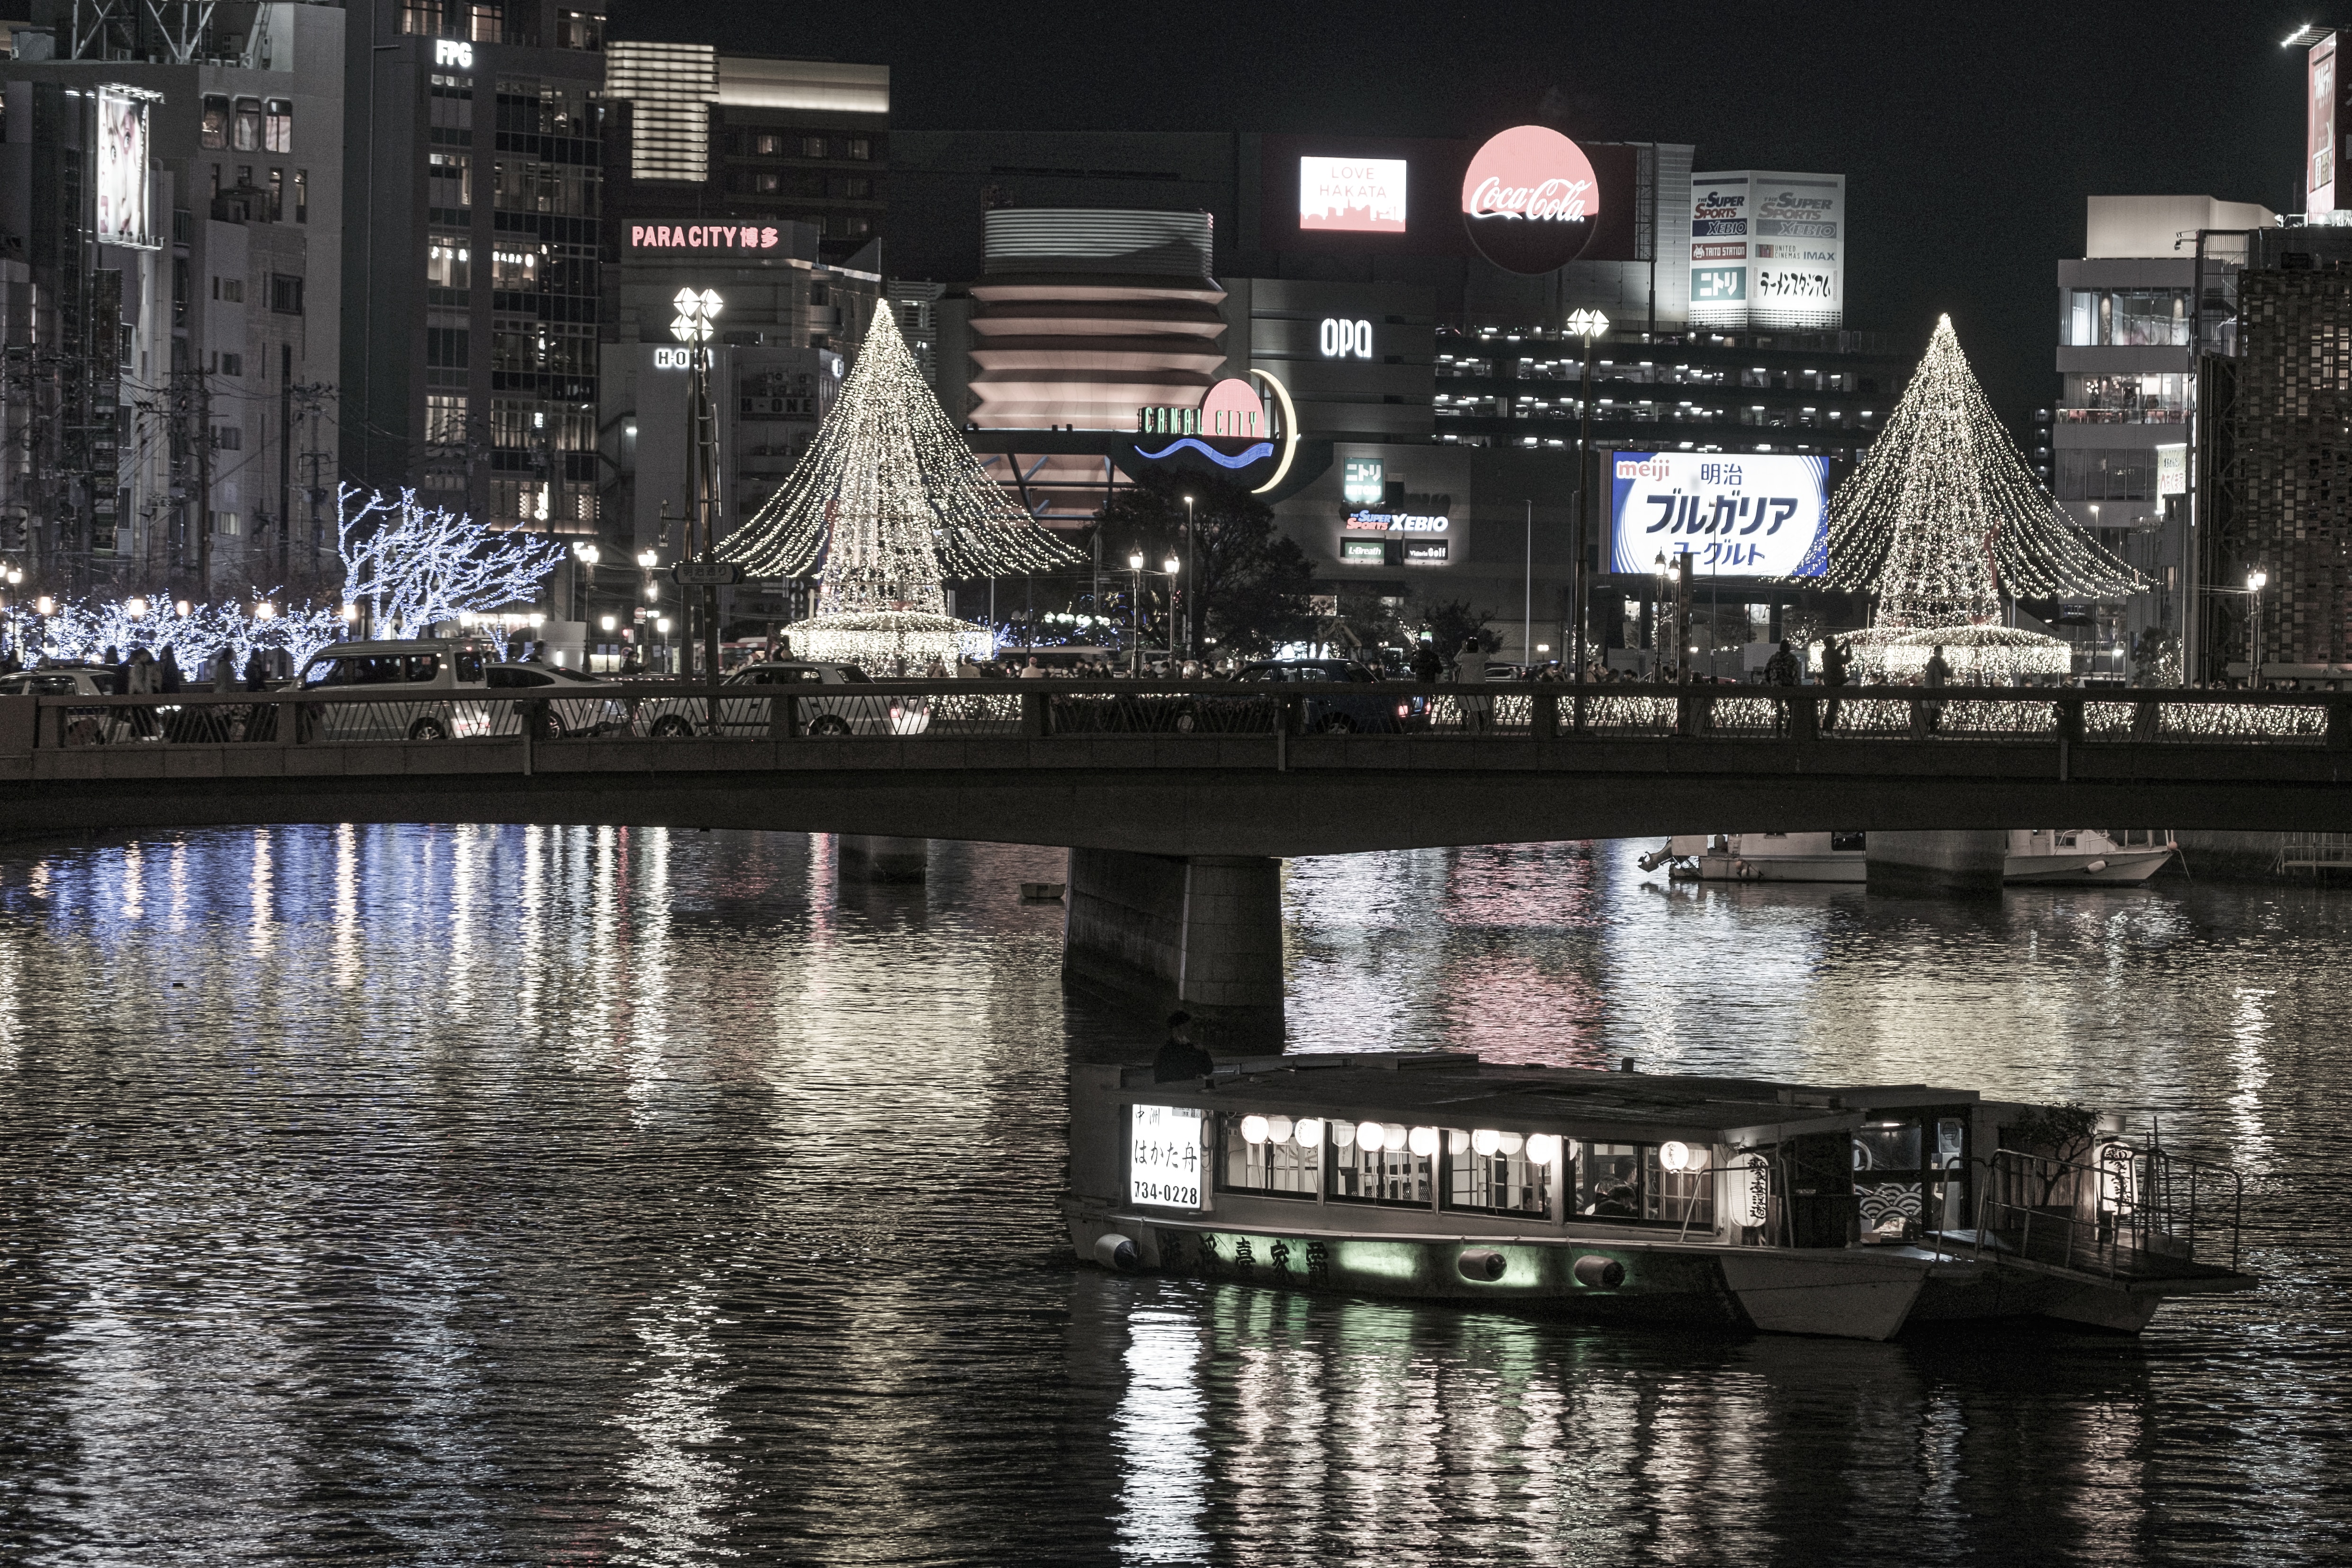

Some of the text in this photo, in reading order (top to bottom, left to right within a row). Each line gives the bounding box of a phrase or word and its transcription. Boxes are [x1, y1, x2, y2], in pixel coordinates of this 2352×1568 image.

[436, 39, 472, 67] FPG
[1331, 166, 1374, 180] LOVE
[1319, 184, 1387, 198] HAKATA
[1706, 191, 1745, 207] SUPER
[1776, 192, 1833, 209] SUPER
[1694, 203, 1737, 219] SPORTS
[1758, 202, 1822, 220] SPORTS
[1706, 220, 1747, 235] XEBIO
[1777, 221, 1836, 237] XEBIO
[740, 227, 779, 248] 博多
[1705, 246, 1745, 257] TAITO STATION
[1775, 244, 1796, 252] UNITED
[1804, 251, 1835, 261] IMAX
[1700, 271, 1738, 296] ニトリ
[1760, 271, 1831, 298] ラーメンスタジアム
[1320, 318, 1372, 358] OPA
[1144, 406, 1257, 437] CANAL CITY
[1346, 464, 1382, 482] ニトリ
[1619, 459, 1670, 482] meiji
[1701, 464, 1742, 485] 明治
[1346, 485, 1381, 495] NITORI
[1358, 510, 1391, 522] SUPER
[1646, 487, 1798, 536] ブルガリア
[1346, 517, 1389, 531] SPORTS
[1389, 513, 1449, 532] XEBIO
[1427, 547, 1446, 557] Golf
[683, 566, 727, 576] 明治通り
[1134, 1138, 1198, 1173] はかた舟
[1134, 1181, 1198, 1205] 734-0228
